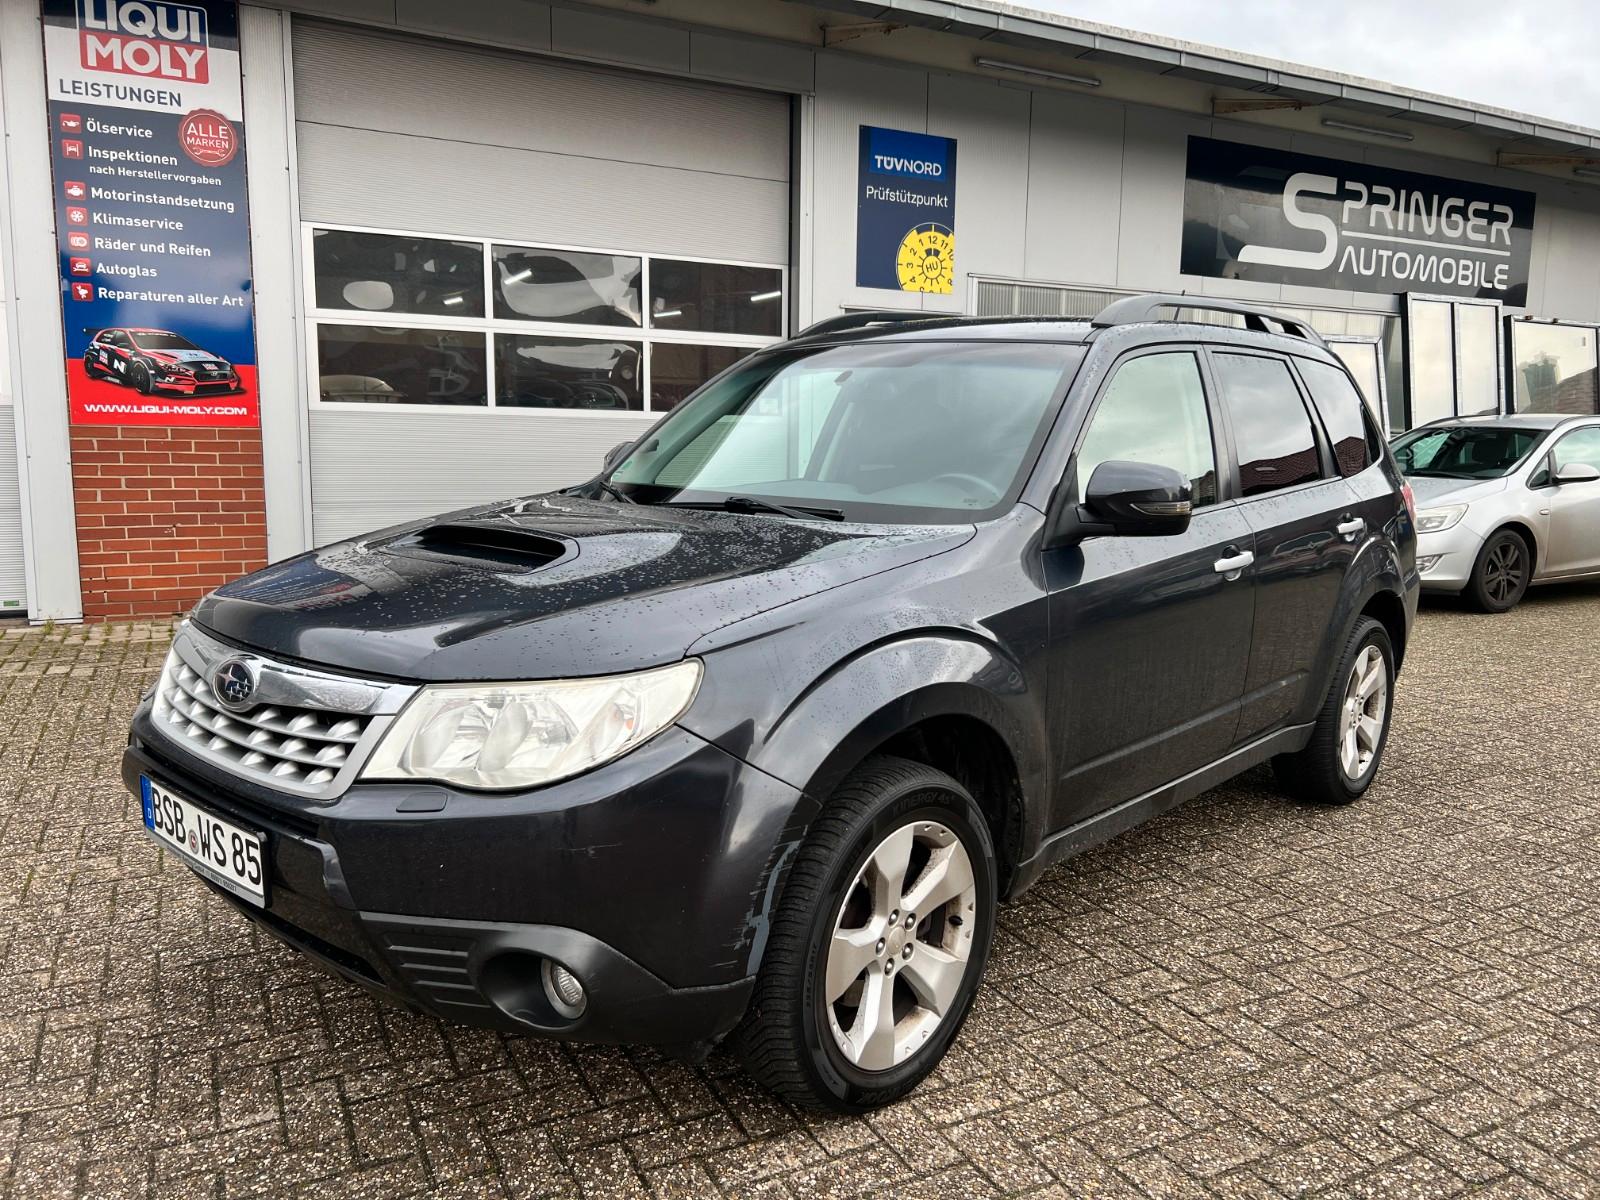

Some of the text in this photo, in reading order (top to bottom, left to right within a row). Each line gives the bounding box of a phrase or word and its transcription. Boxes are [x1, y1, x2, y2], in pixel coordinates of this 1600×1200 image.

[85, 0, 201, 43] LIQUI
[86, 34, 205, 80] MOLY
[59, 78, 182, 107] LEISTUNGEN
[86, 117, 153, 138] Ölservice
[186, 122, 229, 139] ALLE
[186, 136, 229, 149] MARKEN
[88, 146, 178, 166] Inspektionen
[89, 165, 222, 186] nach Herstellervorgaben
[91, 187, 235, 213] Motorinstandsetzung
[866, 185, 949, 208] Prüfstützpunkt
[93, 212, 184, 231] Klimaservice
[1237, 172, 1514, 270] SPRINGER
[95, 237, 211, 257] Räder und Reifen
[928, 235, 937, 244] 12
[96, 262, 158, 278] Autoglas
[926, 261, 938, 272] HU
[1338, 245, 1509, 290] AUTOMOBILE
[98, 287, 244, 306] Reparaturen aller Art
[84, 403, 247, 415] WWW.LIQUI-MOLY.COM
[152, 787, 186, 844] BSB
[197, 814, 227, 868] WS
[231, 832, 262, 886] 85
